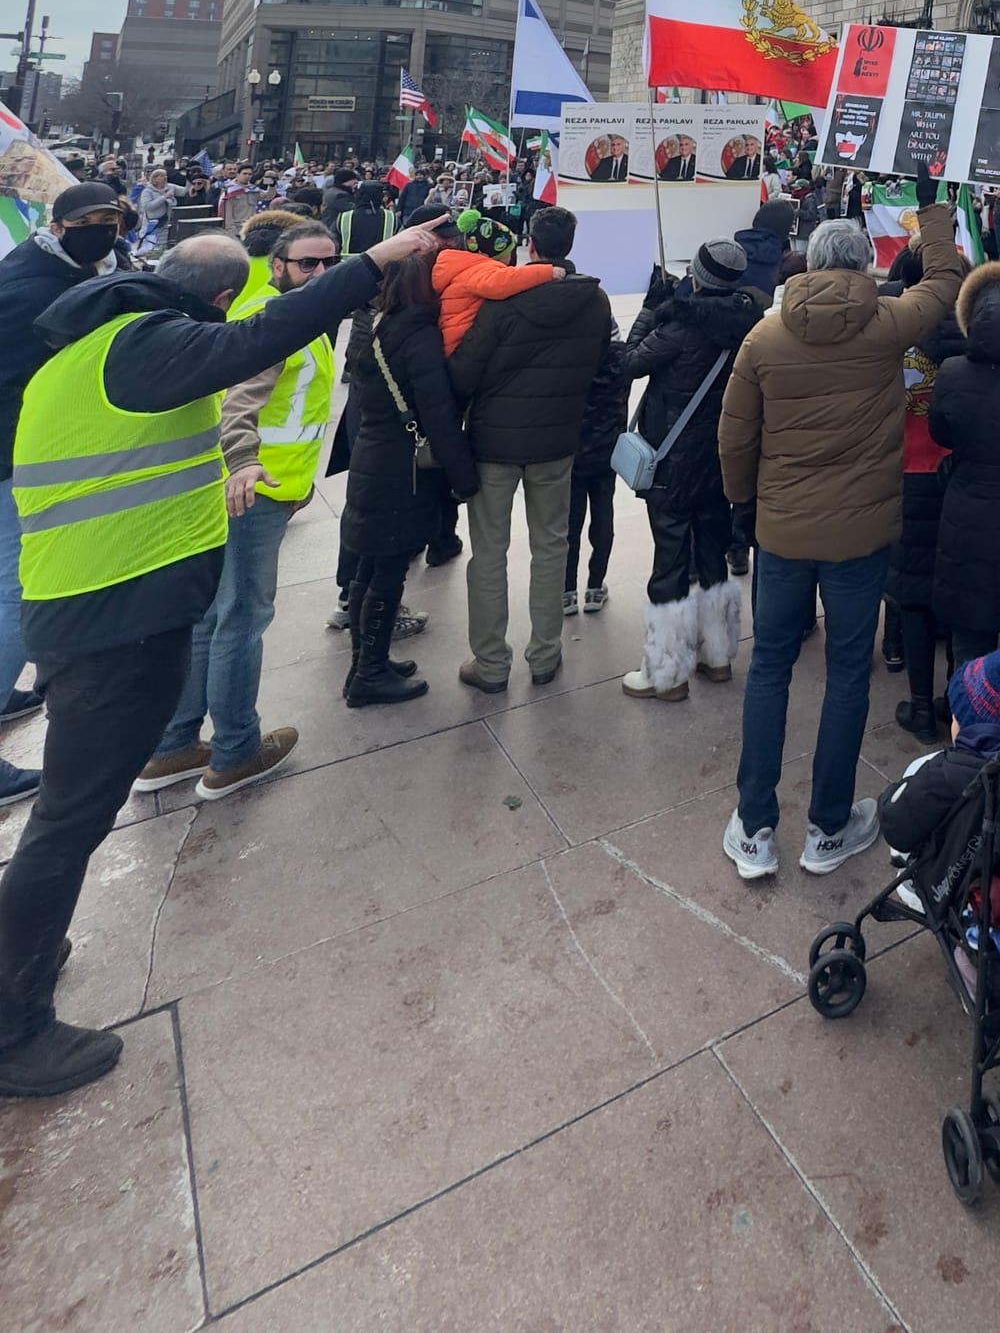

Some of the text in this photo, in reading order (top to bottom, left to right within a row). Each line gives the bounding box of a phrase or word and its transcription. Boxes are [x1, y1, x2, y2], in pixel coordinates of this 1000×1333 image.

[916, 121, 937, 129] WHAT
[925, 132, 940, 140] YOU
[907, 139, 938, 151] DEALING
[817, 838, 844, 851] HOKA
